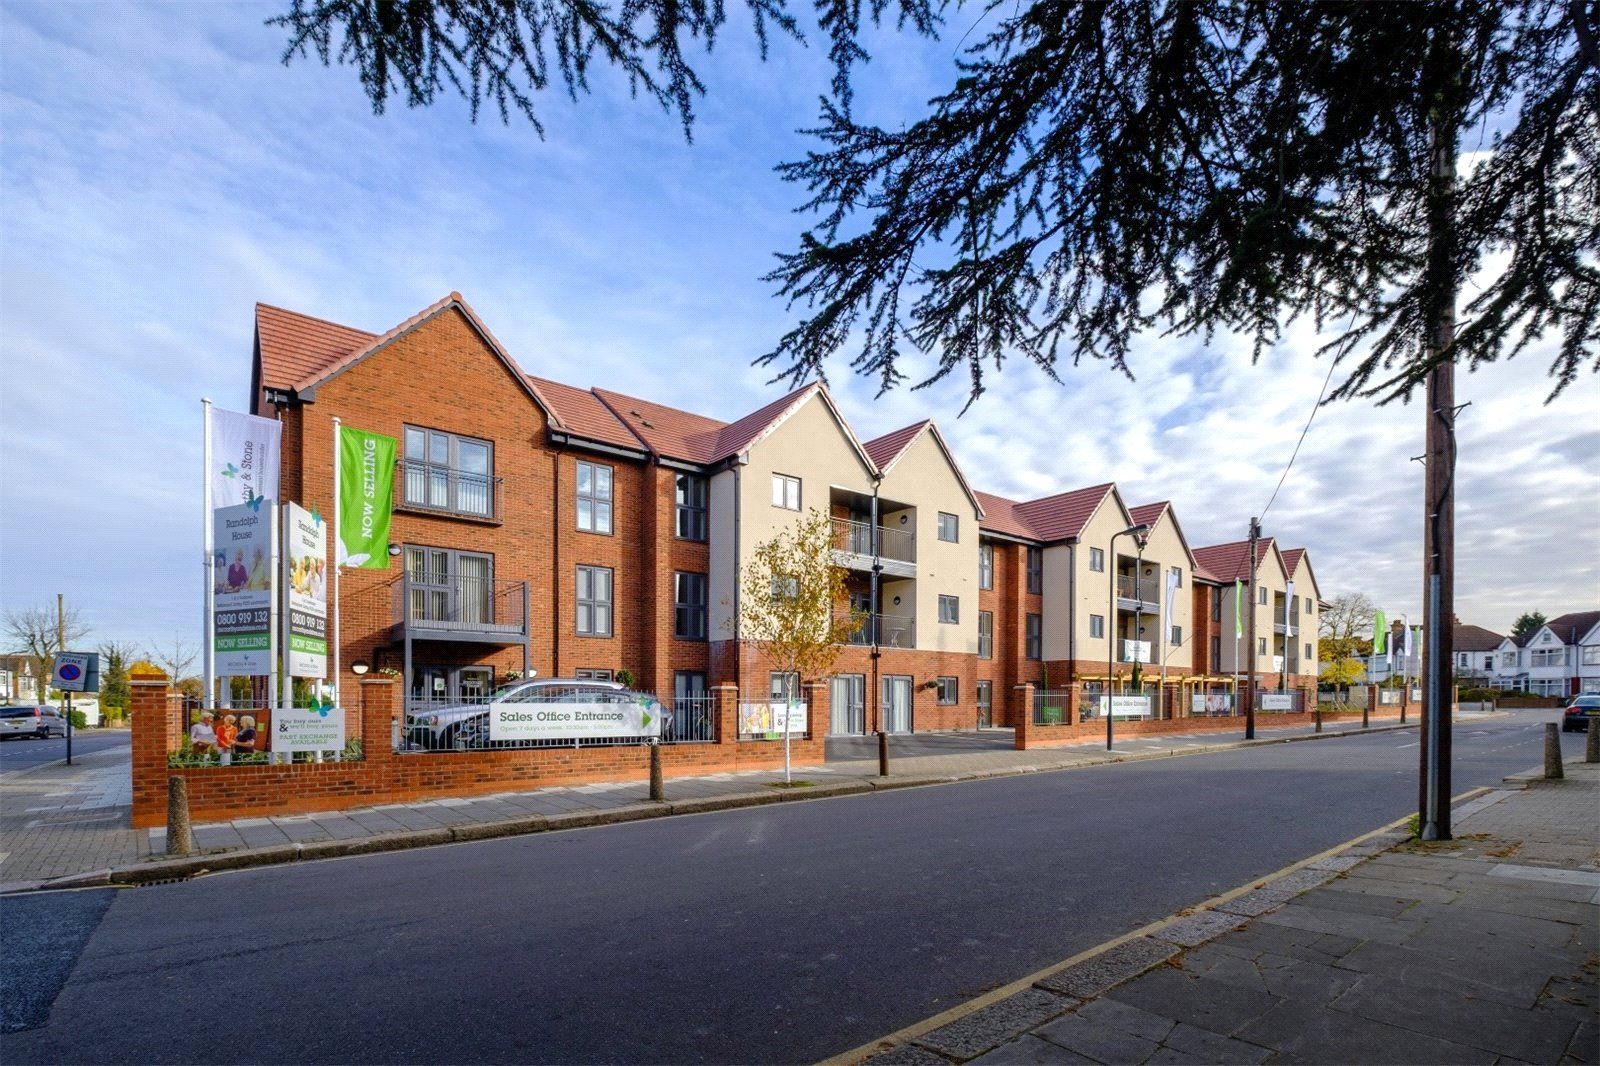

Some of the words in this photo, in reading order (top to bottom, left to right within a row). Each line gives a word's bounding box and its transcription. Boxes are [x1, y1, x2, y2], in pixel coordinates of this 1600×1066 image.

[241, 440, 253, 470] Stone
[364, 439, 377, 499] SELLING
[241, 473, 251, 481] &
[226, 515, 259, 529] Randolph
[362, 503, 373, 539] NOW
[232, 531, 252, 541] House
[217, 613, 237, 625] 0800
[238, 612, 252, 624] 919
[254, 611, 268, 622] 132
[292, 612, 306, 626] 0800
[306, 616, 316, 629] 919
[316, 619, 325, 631] 132
[217, 639, 236, 649] NOW
[237, 637, 267, 648] SELLING
[292, 639, 305, 649] NOW
[305, 641, 325, 653] SELLING
[500, 711, 533, 722] Sales
[536, 711, 571, 721] Office
[574, 711, 624, 721] Entrance
[777, 718, 783, 726] &
[279, 723, 288, 732] &
